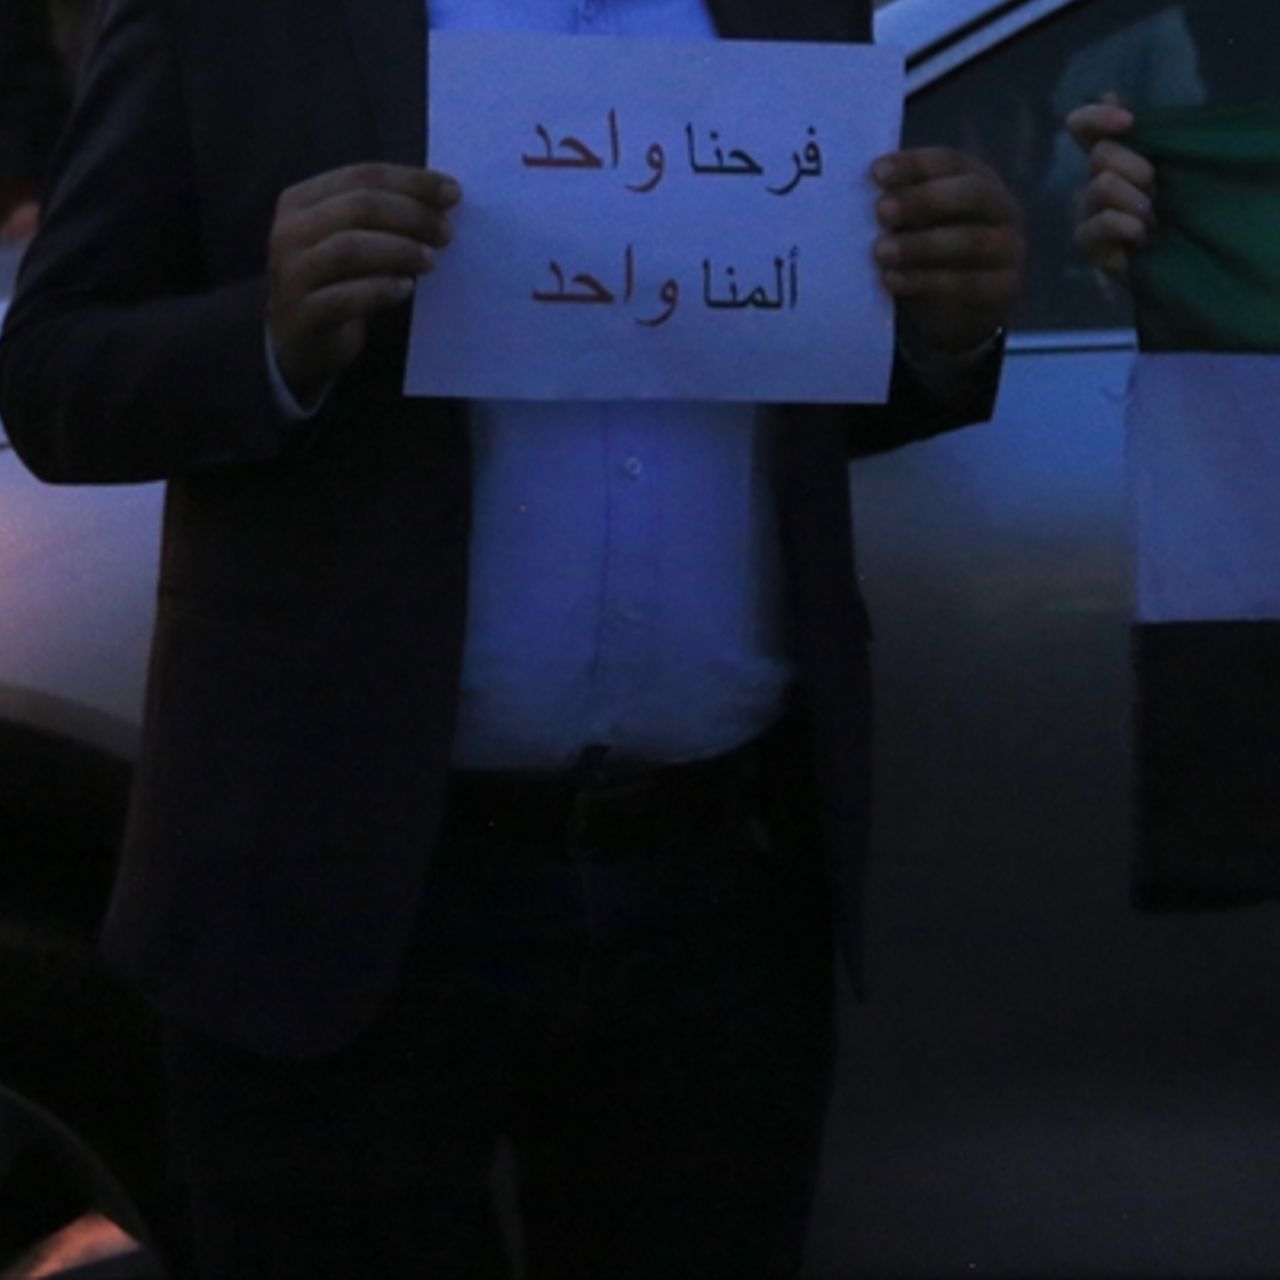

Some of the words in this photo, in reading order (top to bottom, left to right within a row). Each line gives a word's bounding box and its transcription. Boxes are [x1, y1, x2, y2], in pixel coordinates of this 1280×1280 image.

[522, 108, 664, 192] واحد
[686, 123, 822, 195] فرحنا
[532, 245, 678, 326] واحد
[702, 246, 799, 310] ألمنا
